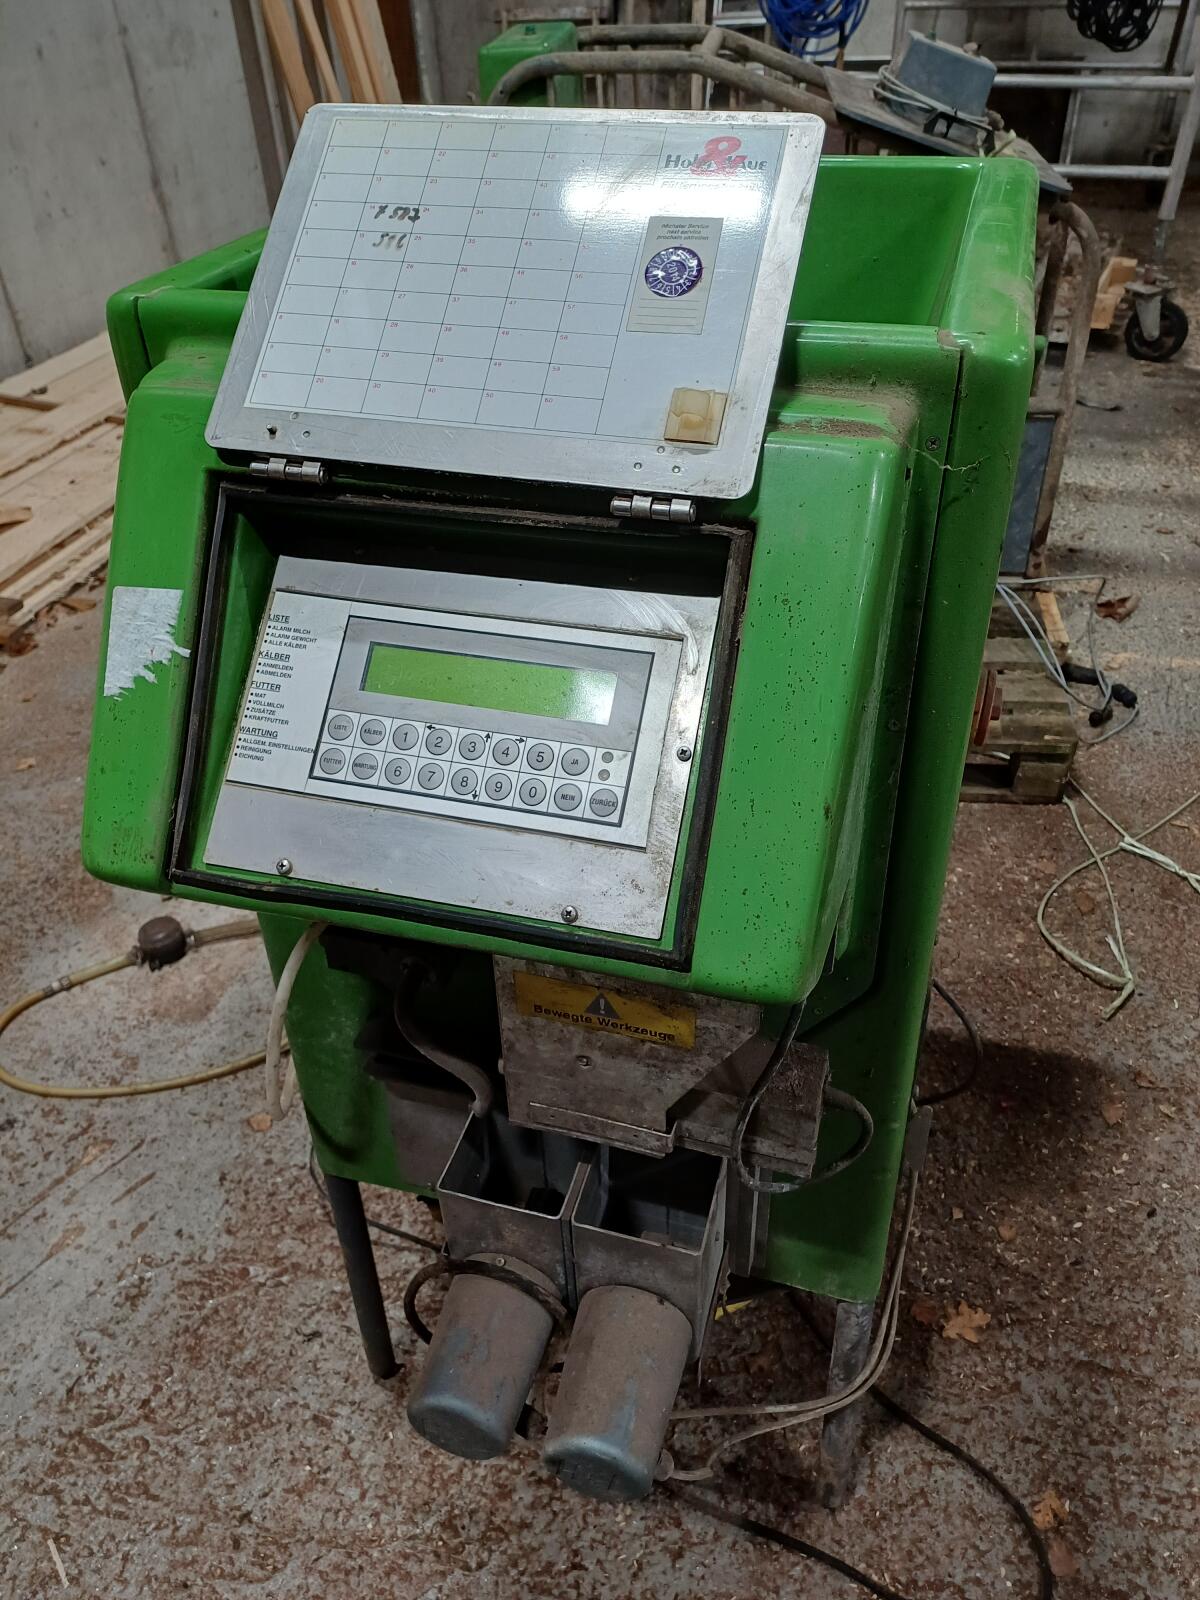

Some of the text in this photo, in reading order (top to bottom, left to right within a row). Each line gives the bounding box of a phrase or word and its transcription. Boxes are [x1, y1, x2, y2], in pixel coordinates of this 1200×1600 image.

[268, 614, 290, 623] LISTE
[291, 635, 318, 644] GEWICHT
[283, 641, 307, 650] KÄLBER
[259, 650, 291, 662] KÄLBER
[262, 662, 294, 671] ANMELDEN
[260, 670, 292, 679] ABMELDEN
[251, 681, 281, 692] FUTTER
[252, 700, 285, 709] VOLLMILCH
[250, 707, 276, 716] ZUSÄTZE
[248, 714, 289, 726] KRAFTFUTTER
[239, 726, 278, 738] WARTUNG
[333, 723, 348, 732] LISTE
[402, 731, 408, 743] 1
[434, 736, 442, 748] 2
[240, 745, 272, 755] REINIGUNG
[468, 740, 477, 753] 3
[501, 746, 510, 758] 4
[238, 752, 265, 762] EICHUNG
[323, 757, 342, 766] FUTTER
[536, 751, 544, 763] 5
[570, 758, 579, 766] JA
[353, 761, 378, 772] WARTUNG
[394, 765, 402, 777] 6
[427, 770, 435, 783] 7
[460, 775, 469, 788] 8
[494, 780, 503, 793] 9
[528, 786, 537, 798] 0
[560, 793, 576, 802] NEIN
[590, 796, 617, 808] ZURÜCK
[533, 1004, 676, 1042] Bewegte Werkzeuge
